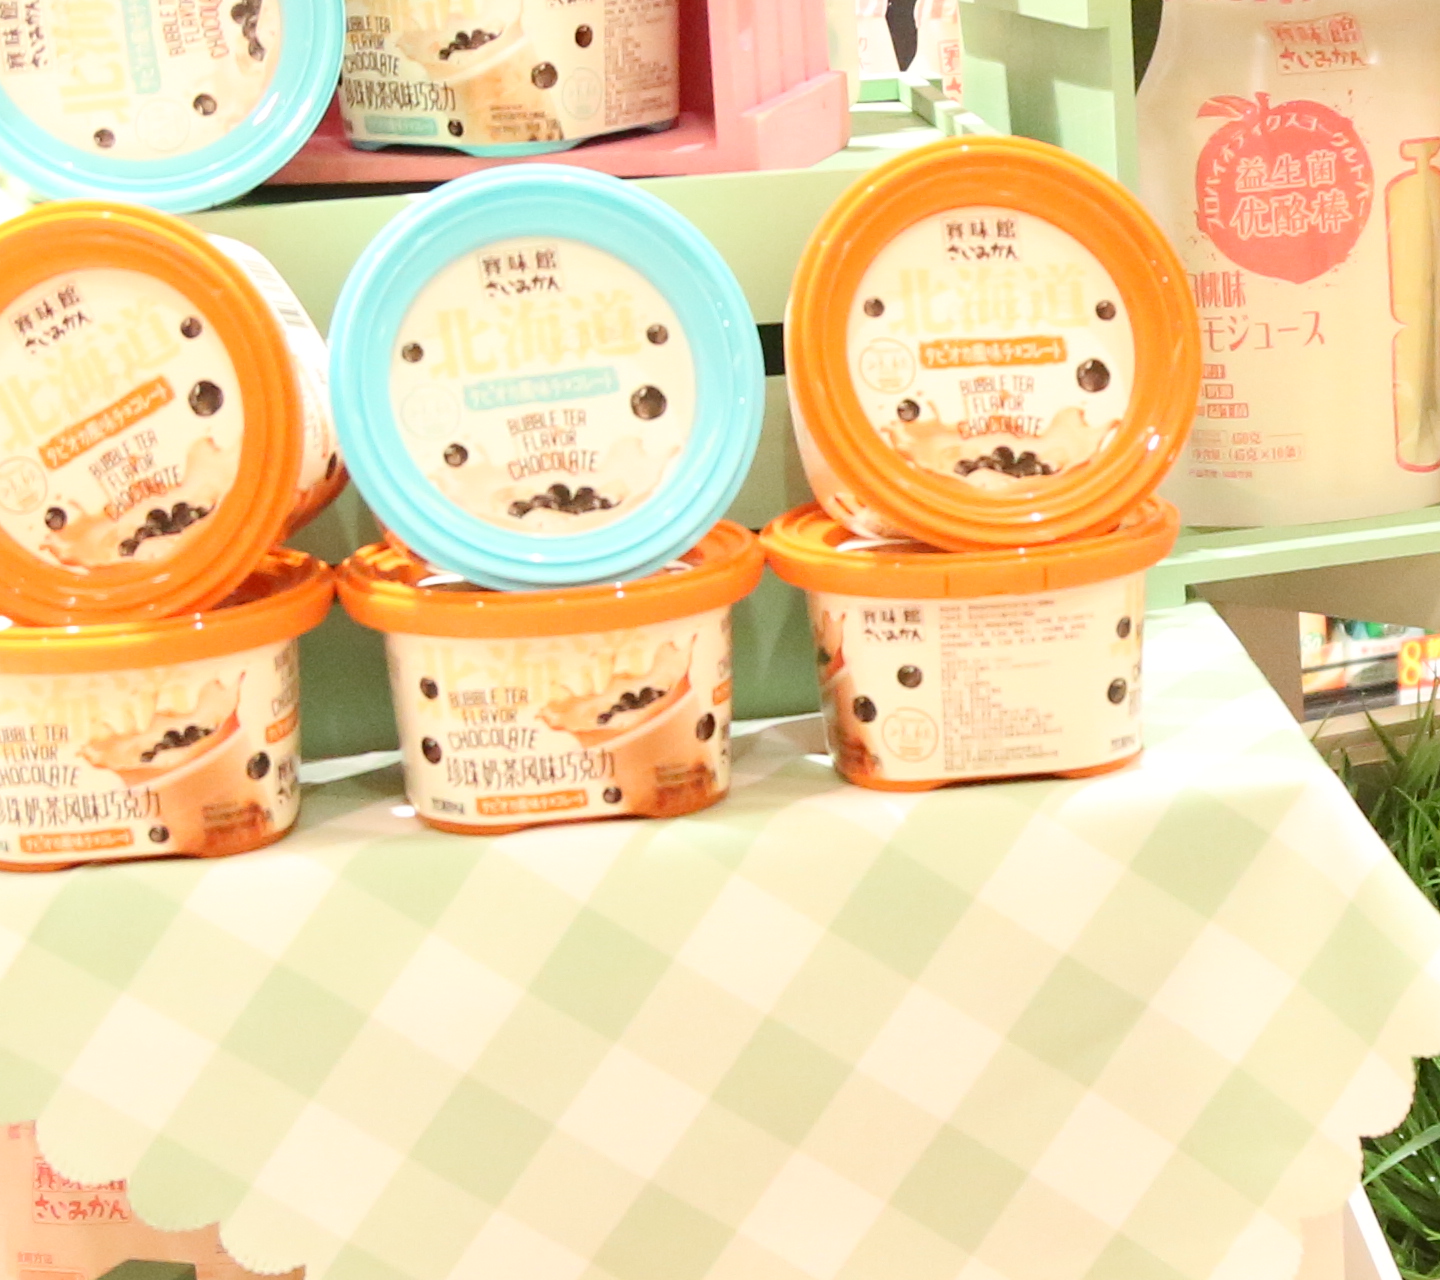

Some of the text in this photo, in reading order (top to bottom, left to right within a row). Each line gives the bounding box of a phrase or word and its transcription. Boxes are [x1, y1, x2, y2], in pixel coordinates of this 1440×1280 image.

[1235, 150, 1337, 194] 益生菌
[1229, 193, 1354, 241] 优酪棒
[1201, 309, 1327, 353] モジュース
[506, 410, 588, 436] BUBBLE TEA
[523, 428, 579, 455] FLAVOR
[506, 448, 599, 480] CHOCOLATE
[448, 684, 529, 707] BUBBLE TEA
[461, 705, 517, 727] FLAVOR
[40, 723, 71, 744] TEA
[447, 725, 538, 752] CHOCOLATE
[1, 742, 59, 764] FLAVOR
[446, 750, 617, 787] 珍珠奶茶风味巧克力
[33, 1193, 129, 1223] さいみかん
